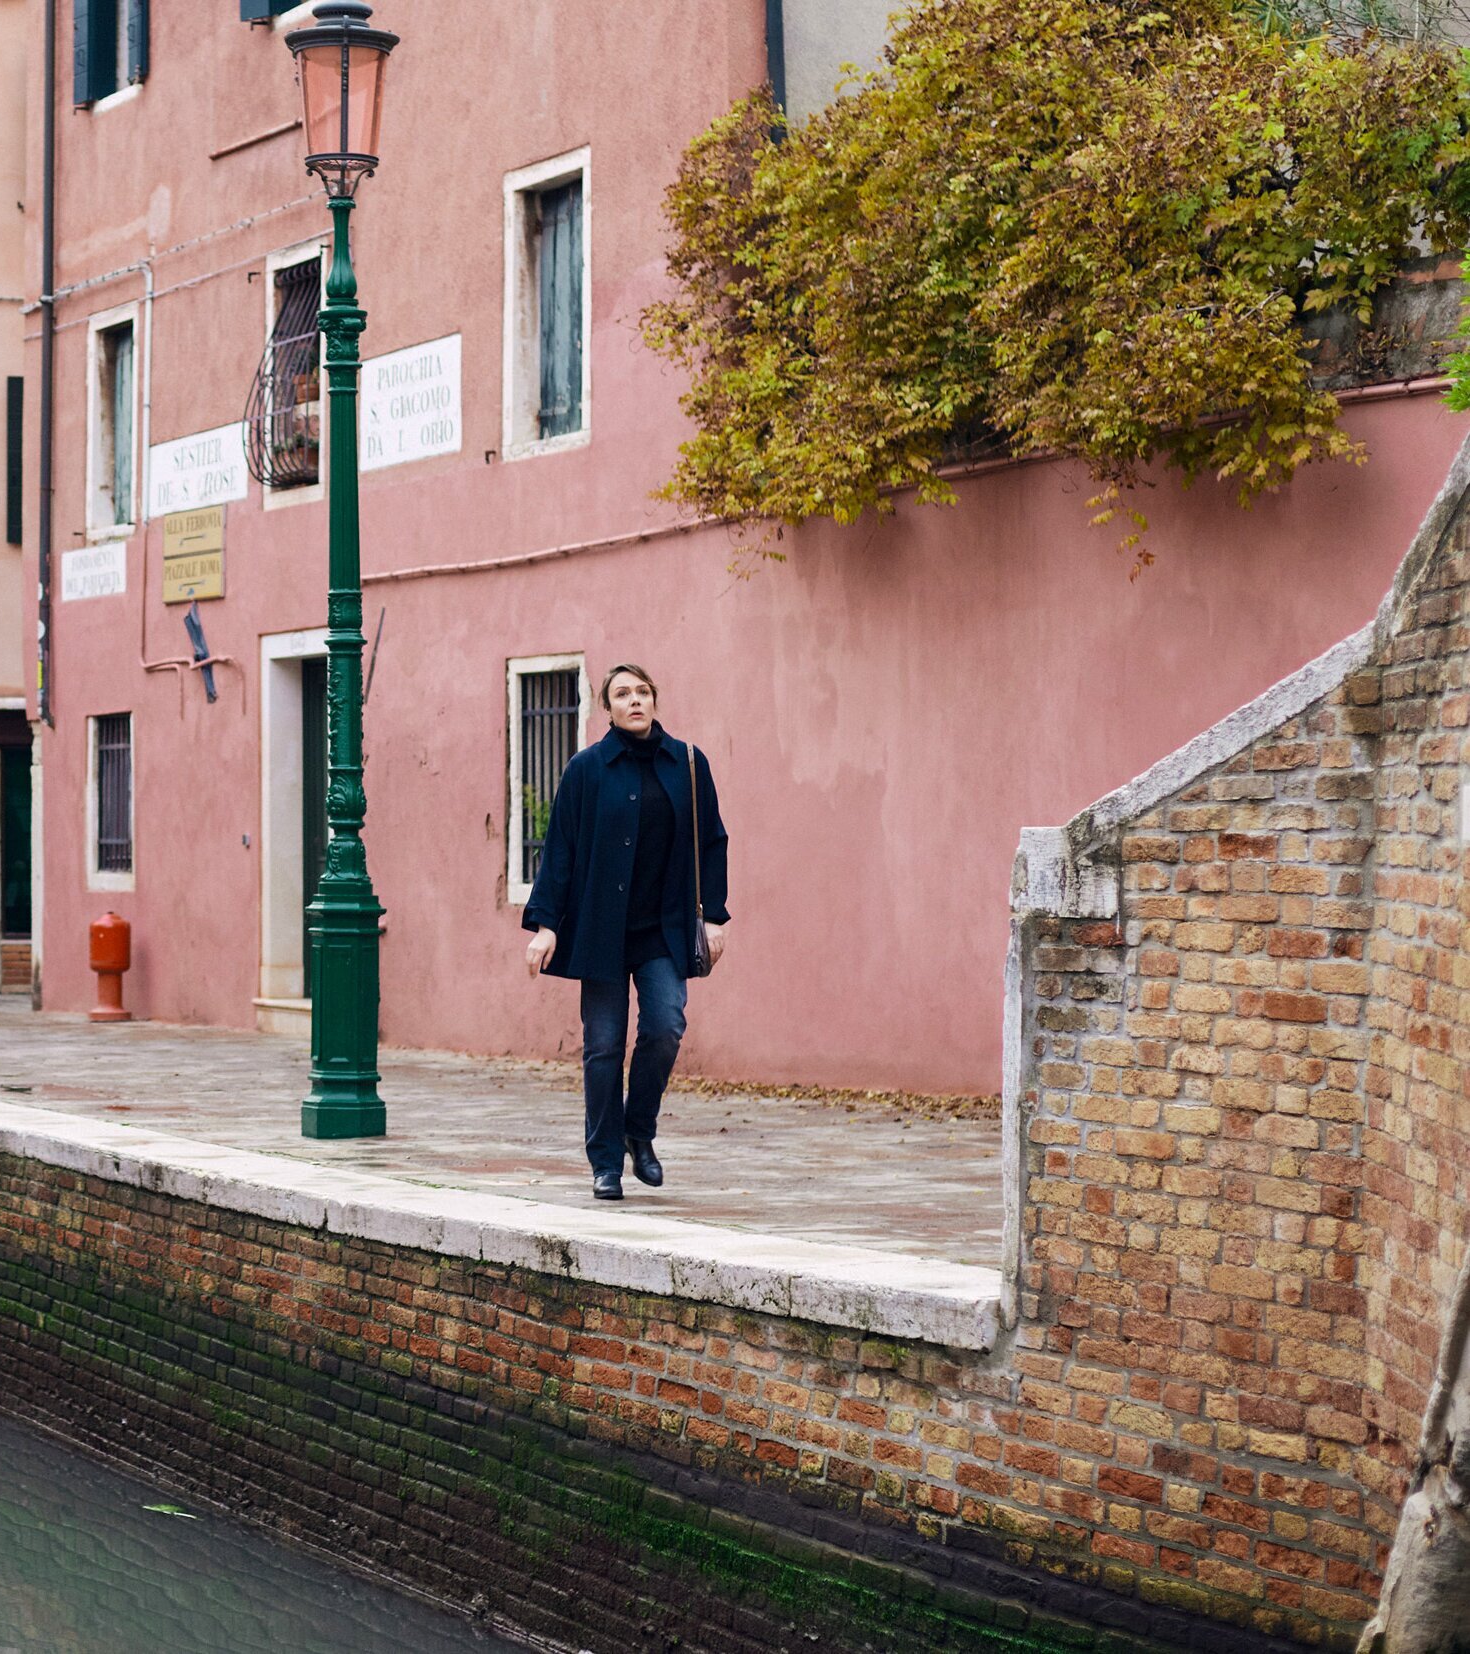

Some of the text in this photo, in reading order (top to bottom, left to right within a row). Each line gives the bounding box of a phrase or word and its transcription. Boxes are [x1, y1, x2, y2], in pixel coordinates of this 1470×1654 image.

[377, 354, 443, 391] PAROCHIA
[390, 385, 451, 420] GIACOMO
[173, 437, 222, 472] SESTIER
[367, 434, 383, 459] DA
[420, 418, 454, 446] ORIO
[165, 511, 222, 535] ALLA FERROVIA
[164, 558, 221, 581] PIAZZALE ROMA
